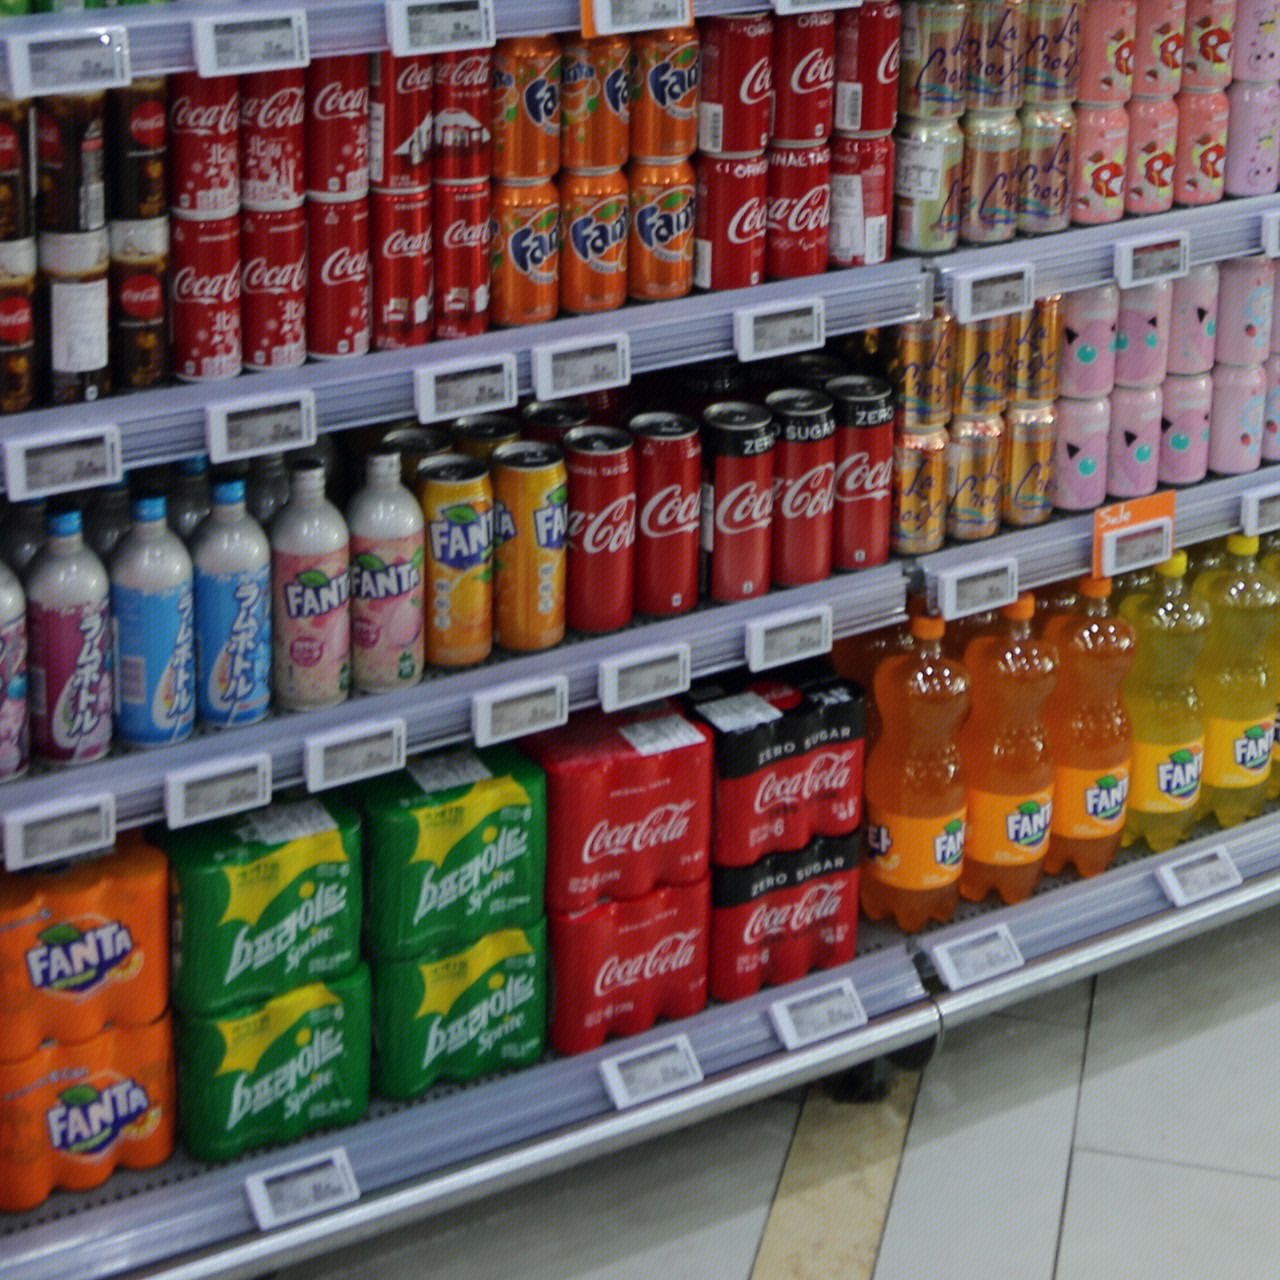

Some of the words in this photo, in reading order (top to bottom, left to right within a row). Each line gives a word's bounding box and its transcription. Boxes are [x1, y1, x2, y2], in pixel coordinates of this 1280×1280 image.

[758, 741, 797, 765] ZERO
[804, 725, 852, 751] SUGAR
[753, 749, 856, 814] Coca-Cola
[582, 799, 697, 865] Coca-Cola
[751, 872, 788, 896] ZERO
[796, 855, 846, 881] SUGAR
[742, 880, 849, 945] Coca-Cola
[27, 923, 134, 986] FANTA
[594, 928, 702, 997] Coca-Cola
[48, 1081, 150, 1150] FANTA
